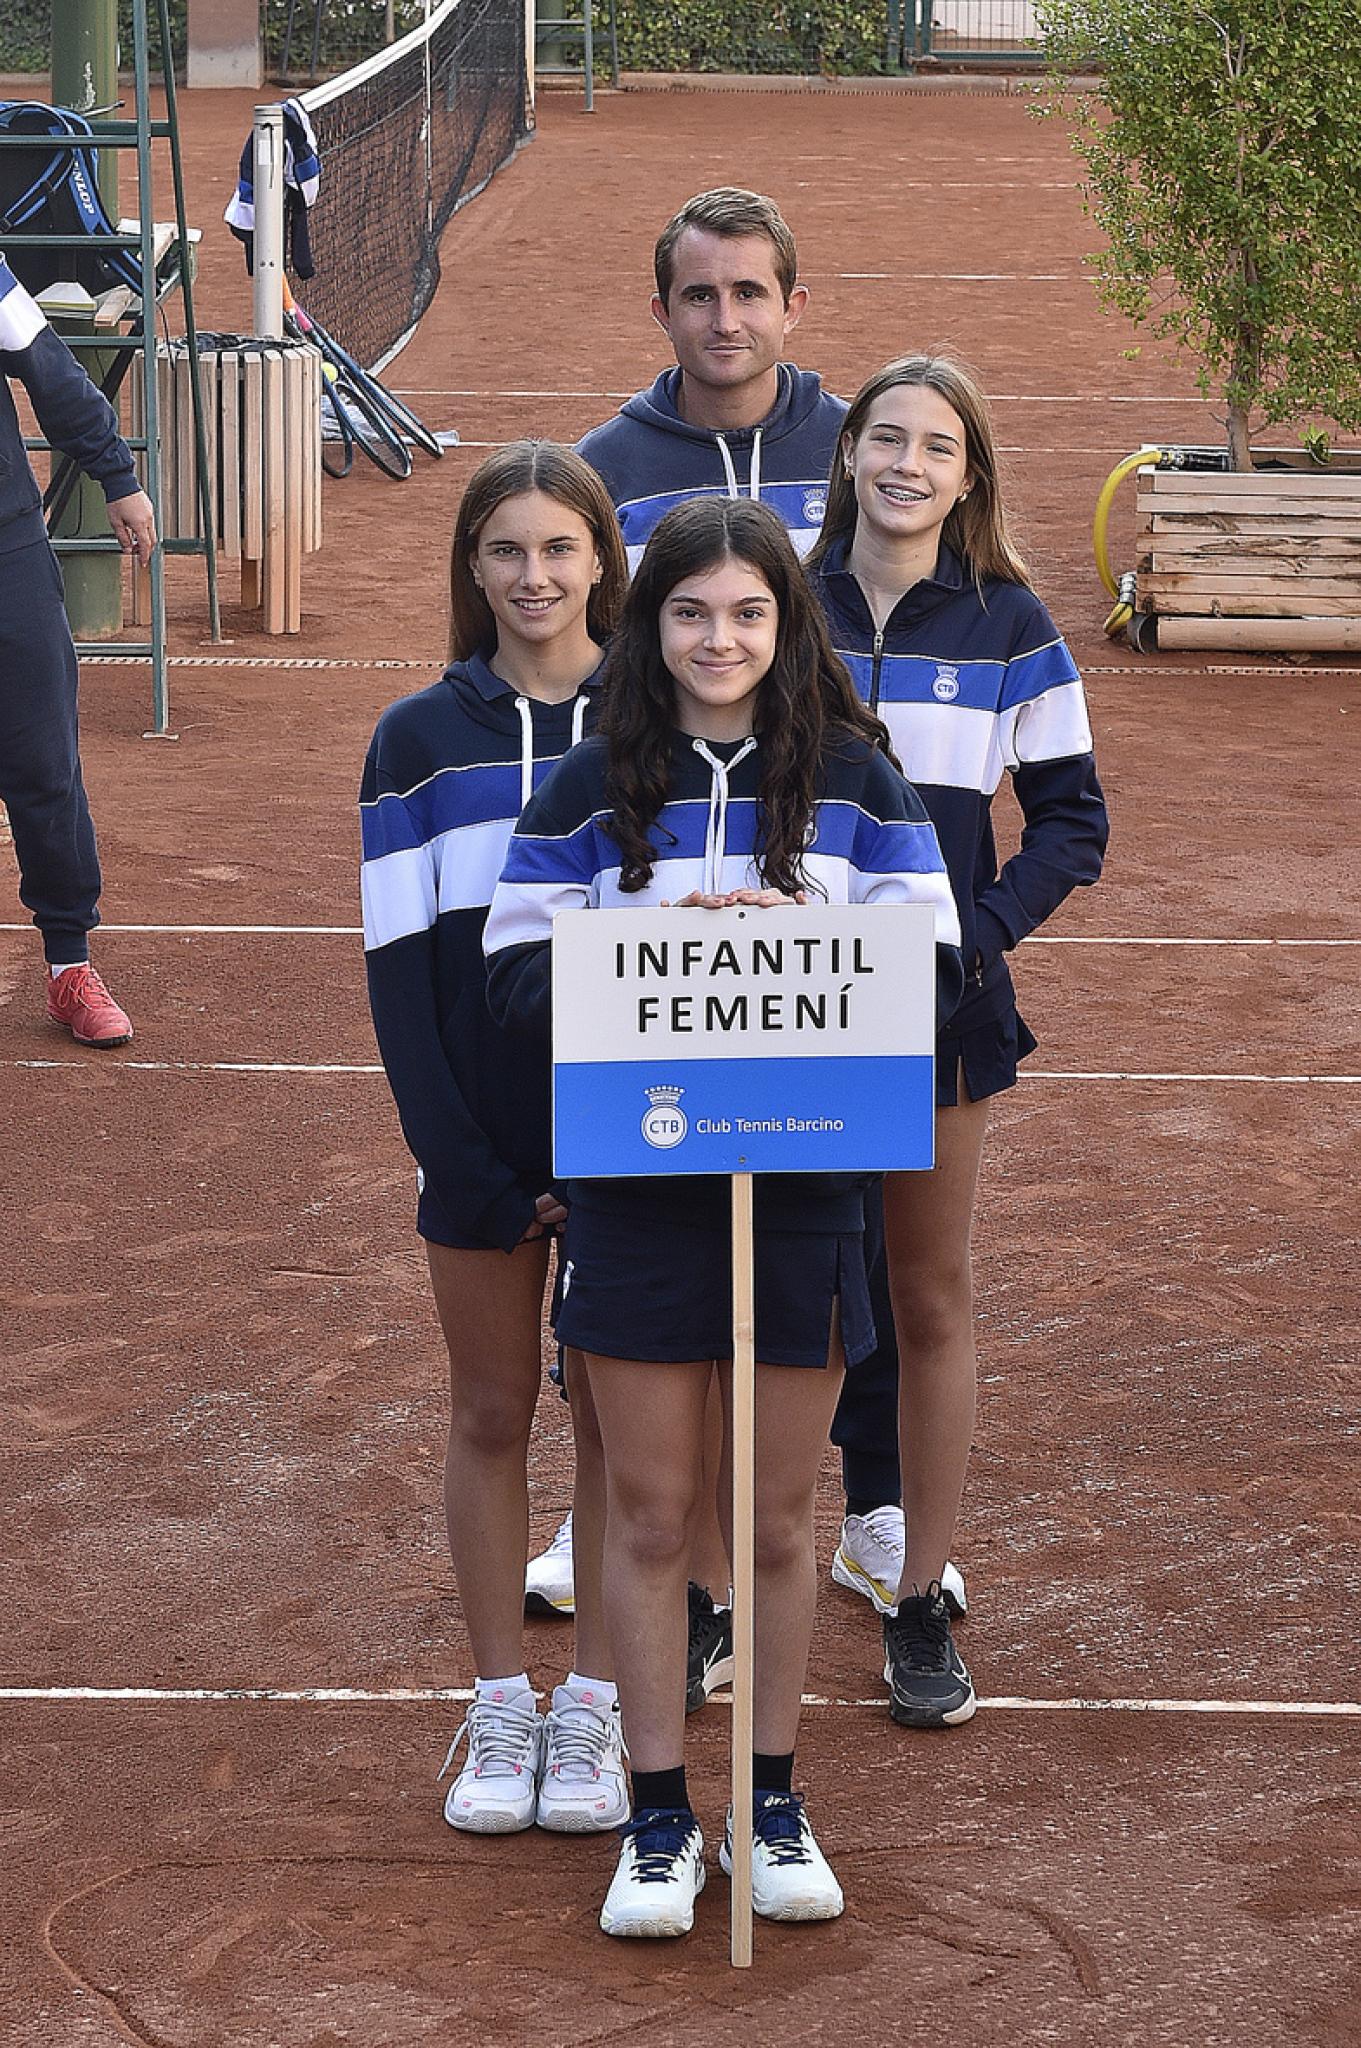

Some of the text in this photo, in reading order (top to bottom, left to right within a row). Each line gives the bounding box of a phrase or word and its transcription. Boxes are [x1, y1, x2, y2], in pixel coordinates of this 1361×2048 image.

[616, 937, 874, 978] INFANTIL
[638, 983, 853, 1032] FEMENÍ
[649, 1119, 680, 1134] CTB
[696, 1116, 844, 1134] Club Tennis Barcino
